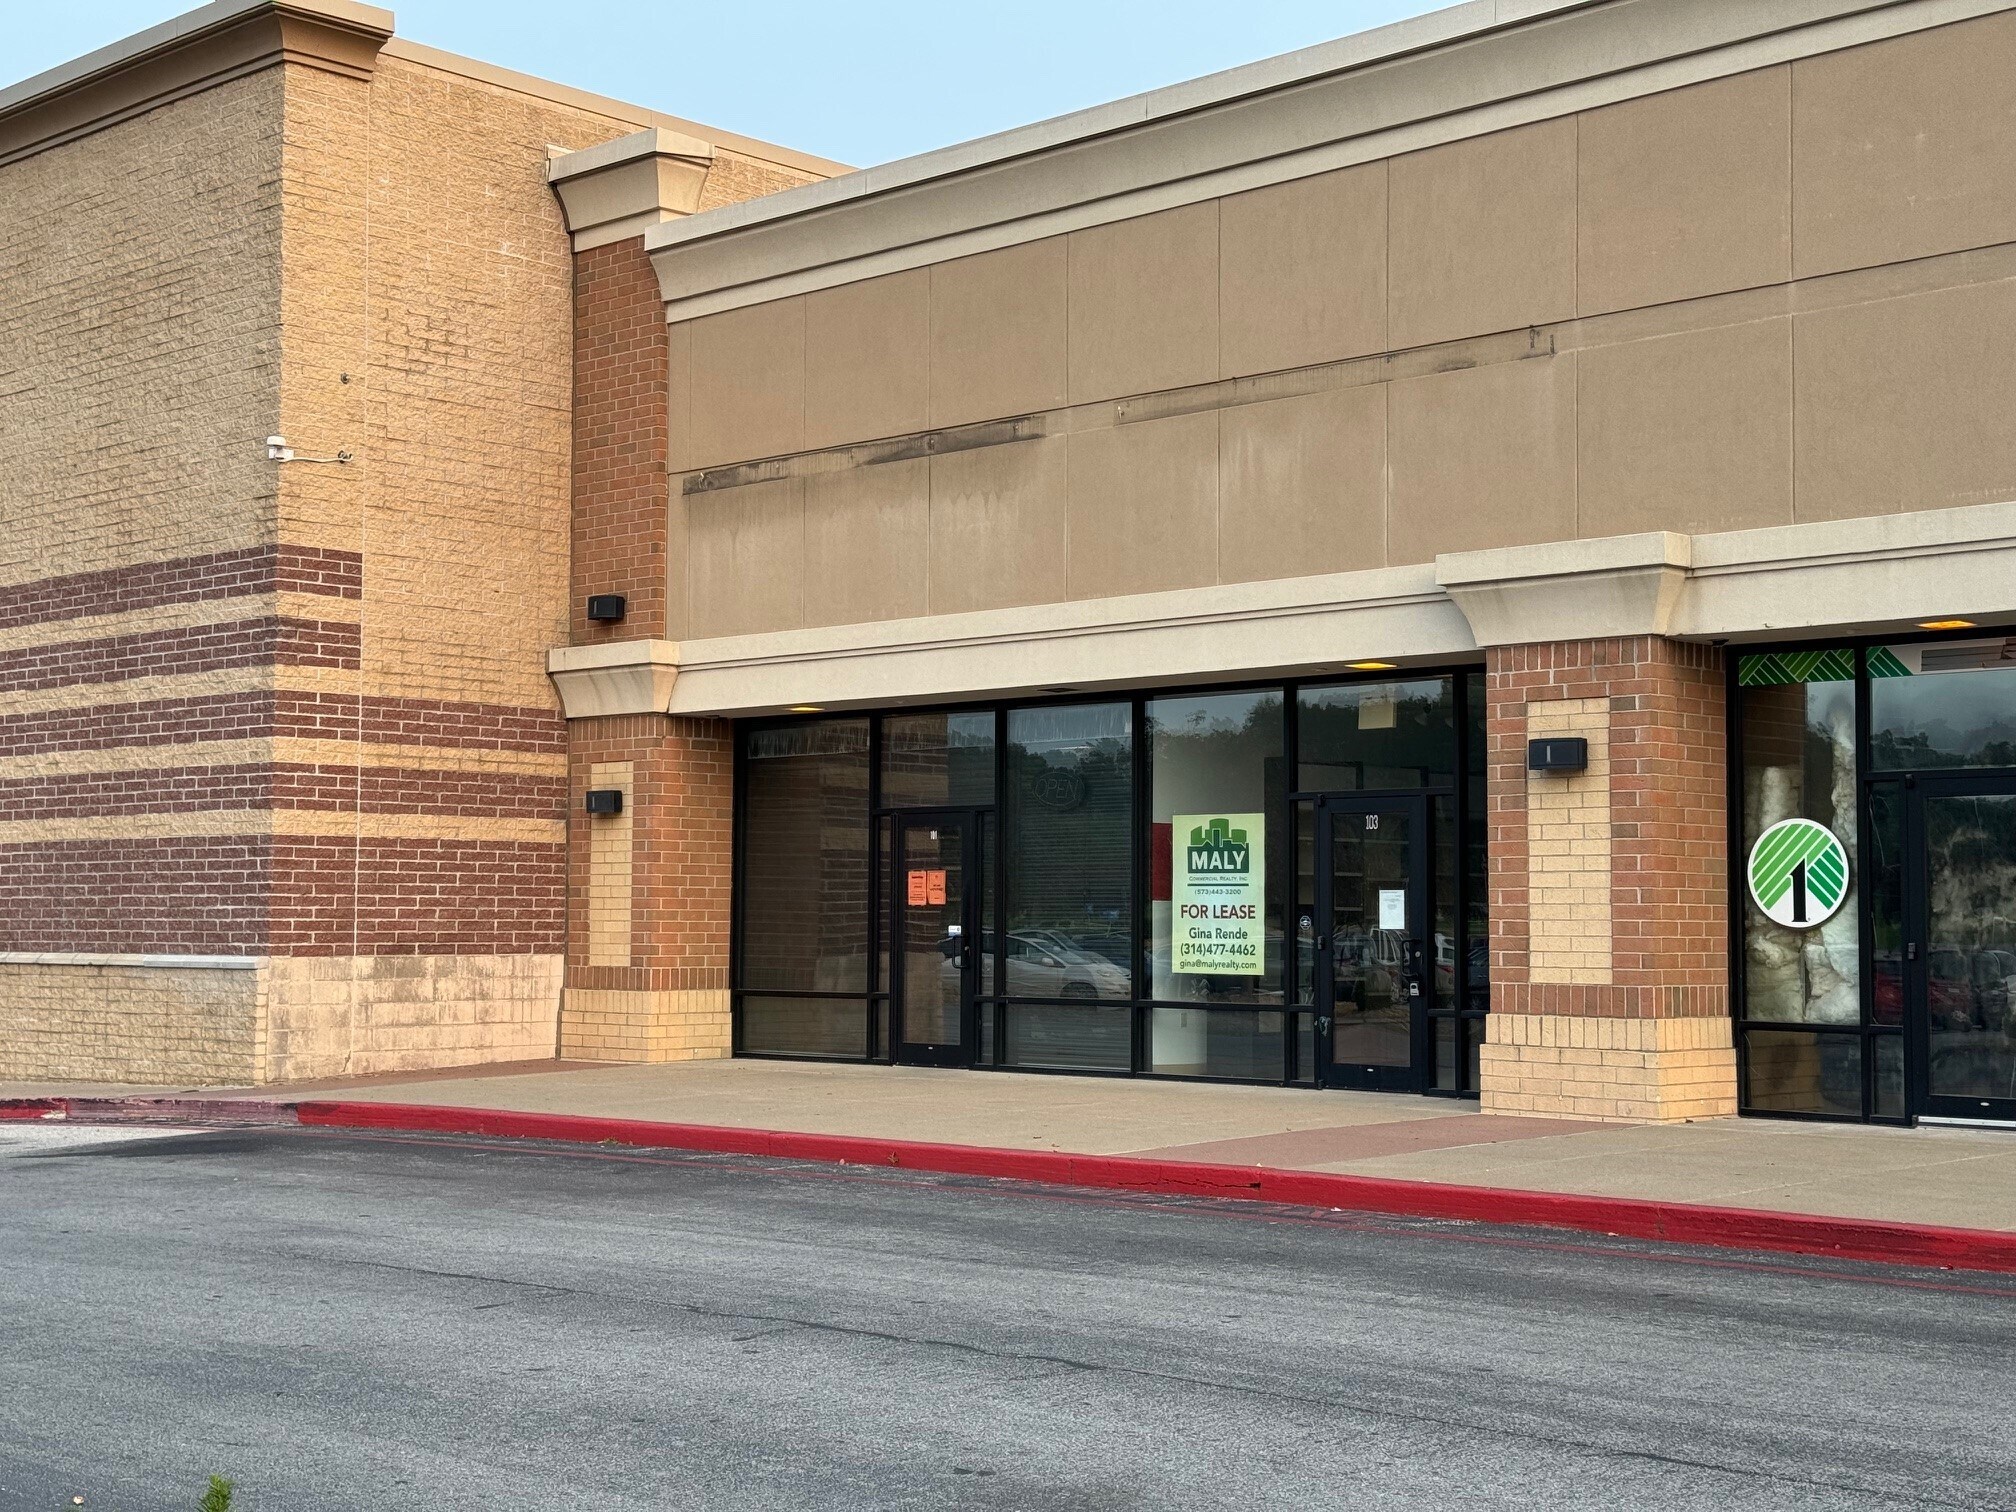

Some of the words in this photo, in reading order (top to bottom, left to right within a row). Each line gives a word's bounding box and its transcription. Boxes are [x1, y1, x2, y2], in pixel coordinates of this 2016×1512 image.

[1036, 778, 1081, 800] OPEN
[1366, 815, 1378, 829] 103
[1191, 851, 1245, 869] MALY
[1181, 905, 1208, 919] FOR
[1213, 905, 1255, 919] LEASE
[1189, 928, 1211, 939] Gina
[1215, 928, 1248, 939] Rende
[1180, 944, 1255, 956] (314)477-4462
[1180, 960, 1256, 970] gina@malyrealty.com
